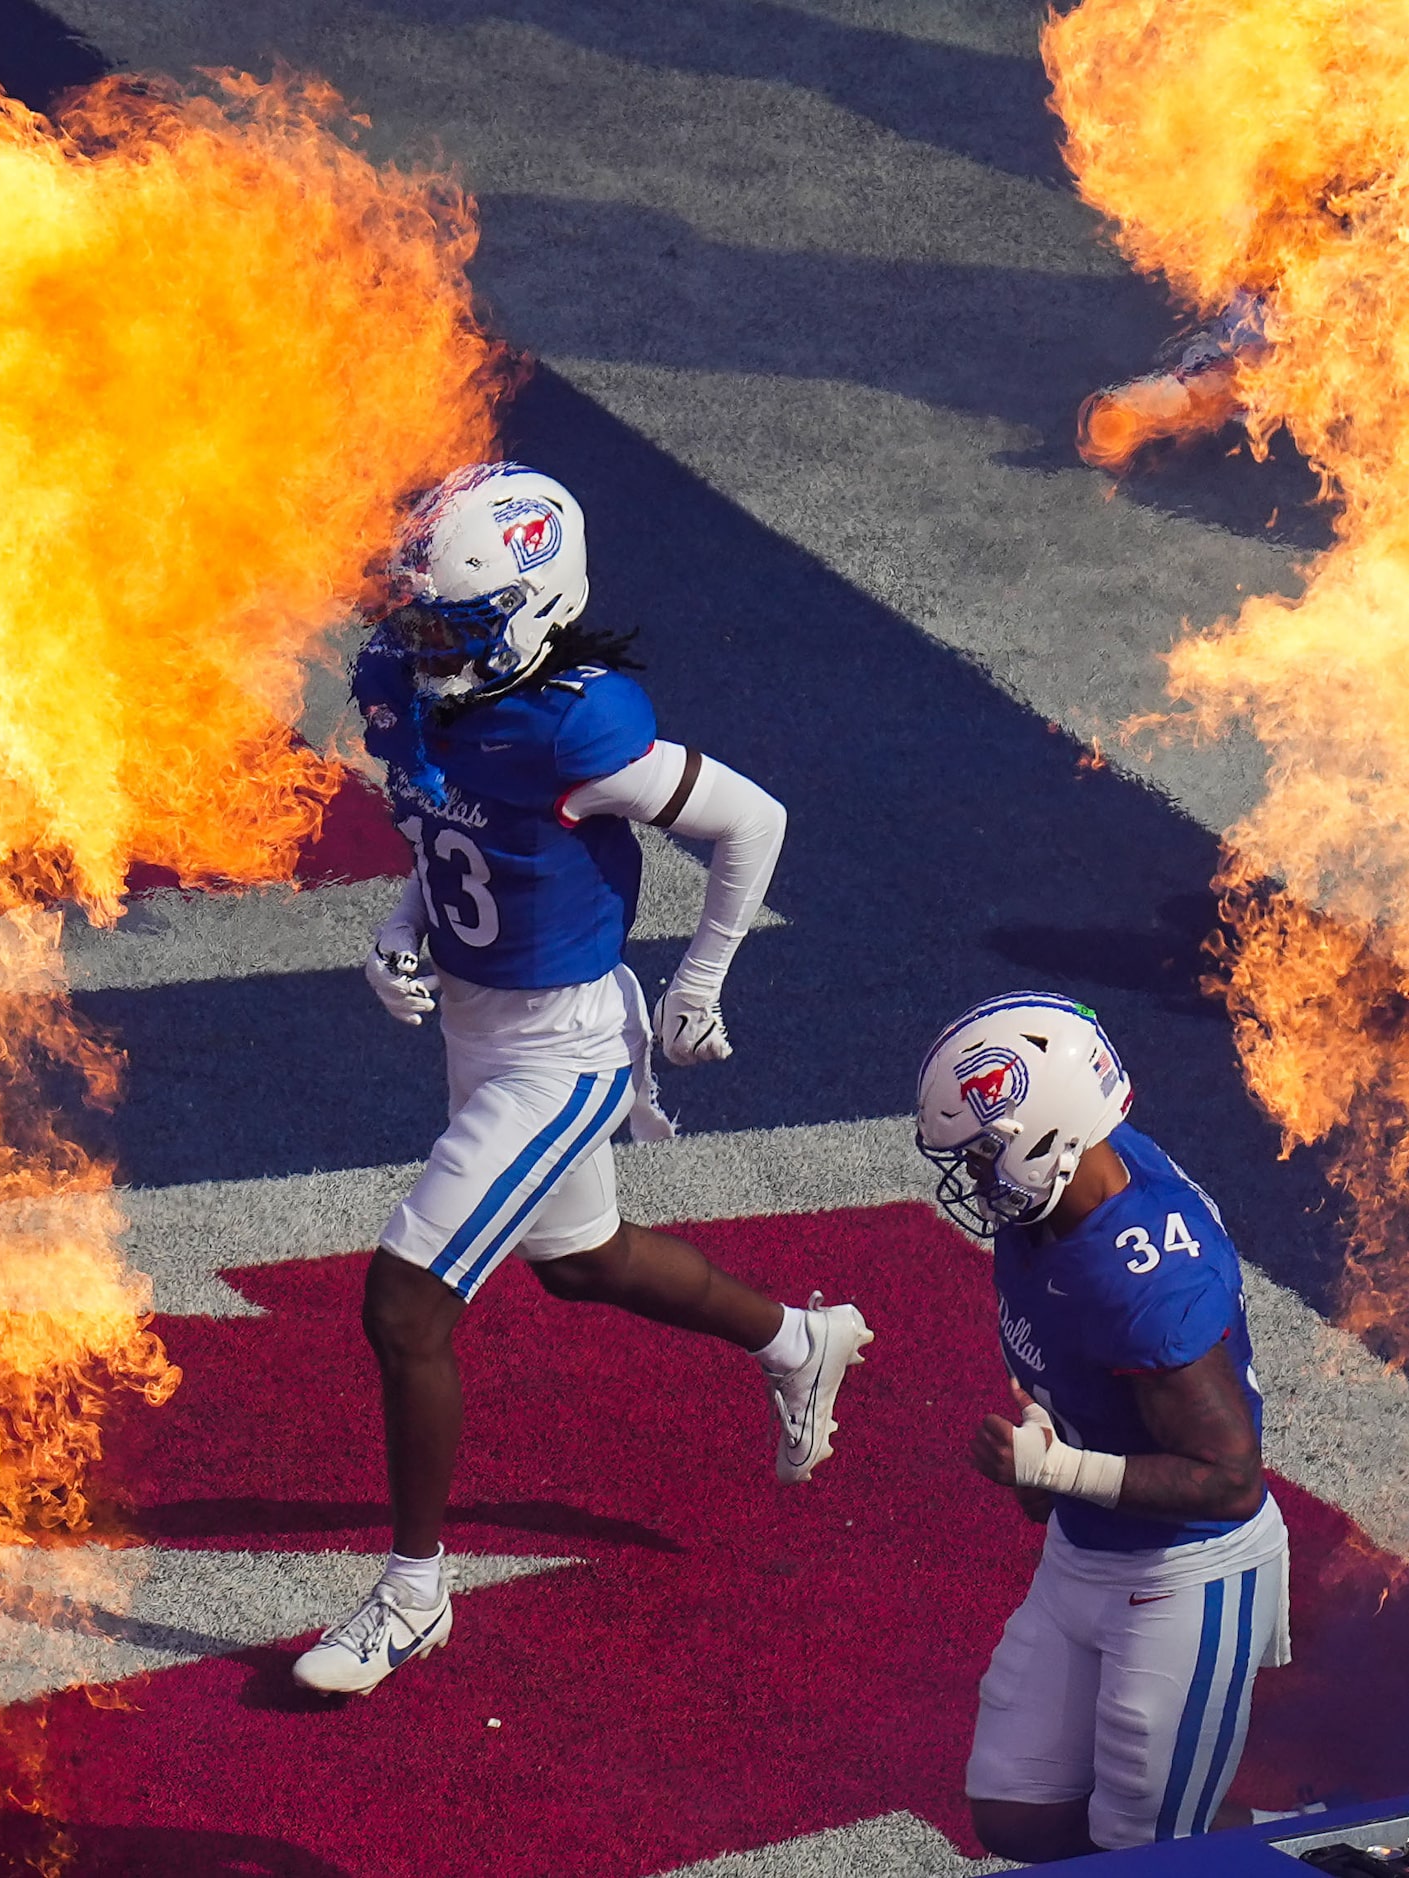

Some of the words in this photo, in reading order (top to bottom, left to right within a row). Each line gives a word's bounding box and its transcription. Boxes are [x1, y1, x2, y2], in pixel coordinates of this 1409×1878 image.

[397, 814, 500, 947] 13
[1115, 1212, 1201, 1274] 34
[998, 1296, 1046, 1372] Dallas
